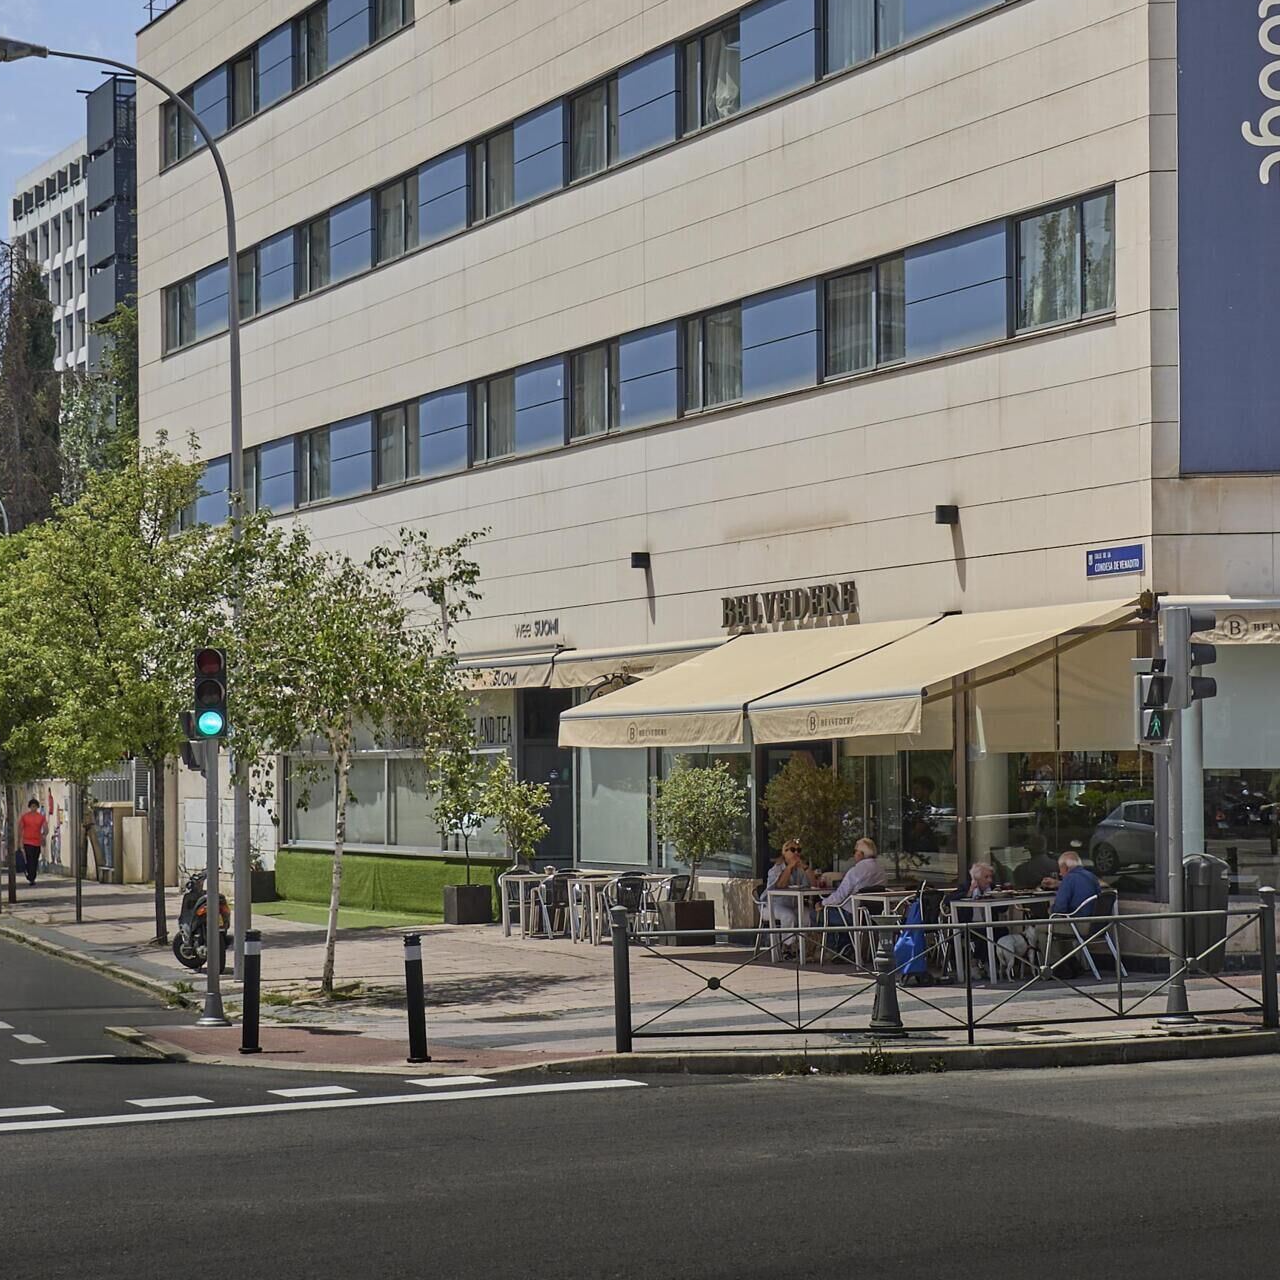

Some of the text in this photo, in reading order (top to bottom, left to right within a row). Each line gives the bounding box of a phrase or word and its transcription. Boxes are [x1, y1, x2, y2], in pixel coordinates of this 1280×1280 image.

[721, 581, 859, 628] BELVEDERE
[534, 617, 559, 637] SUOMI
[480, 716, 495, 743] AND
[496, 716, 512, 743] TEA
